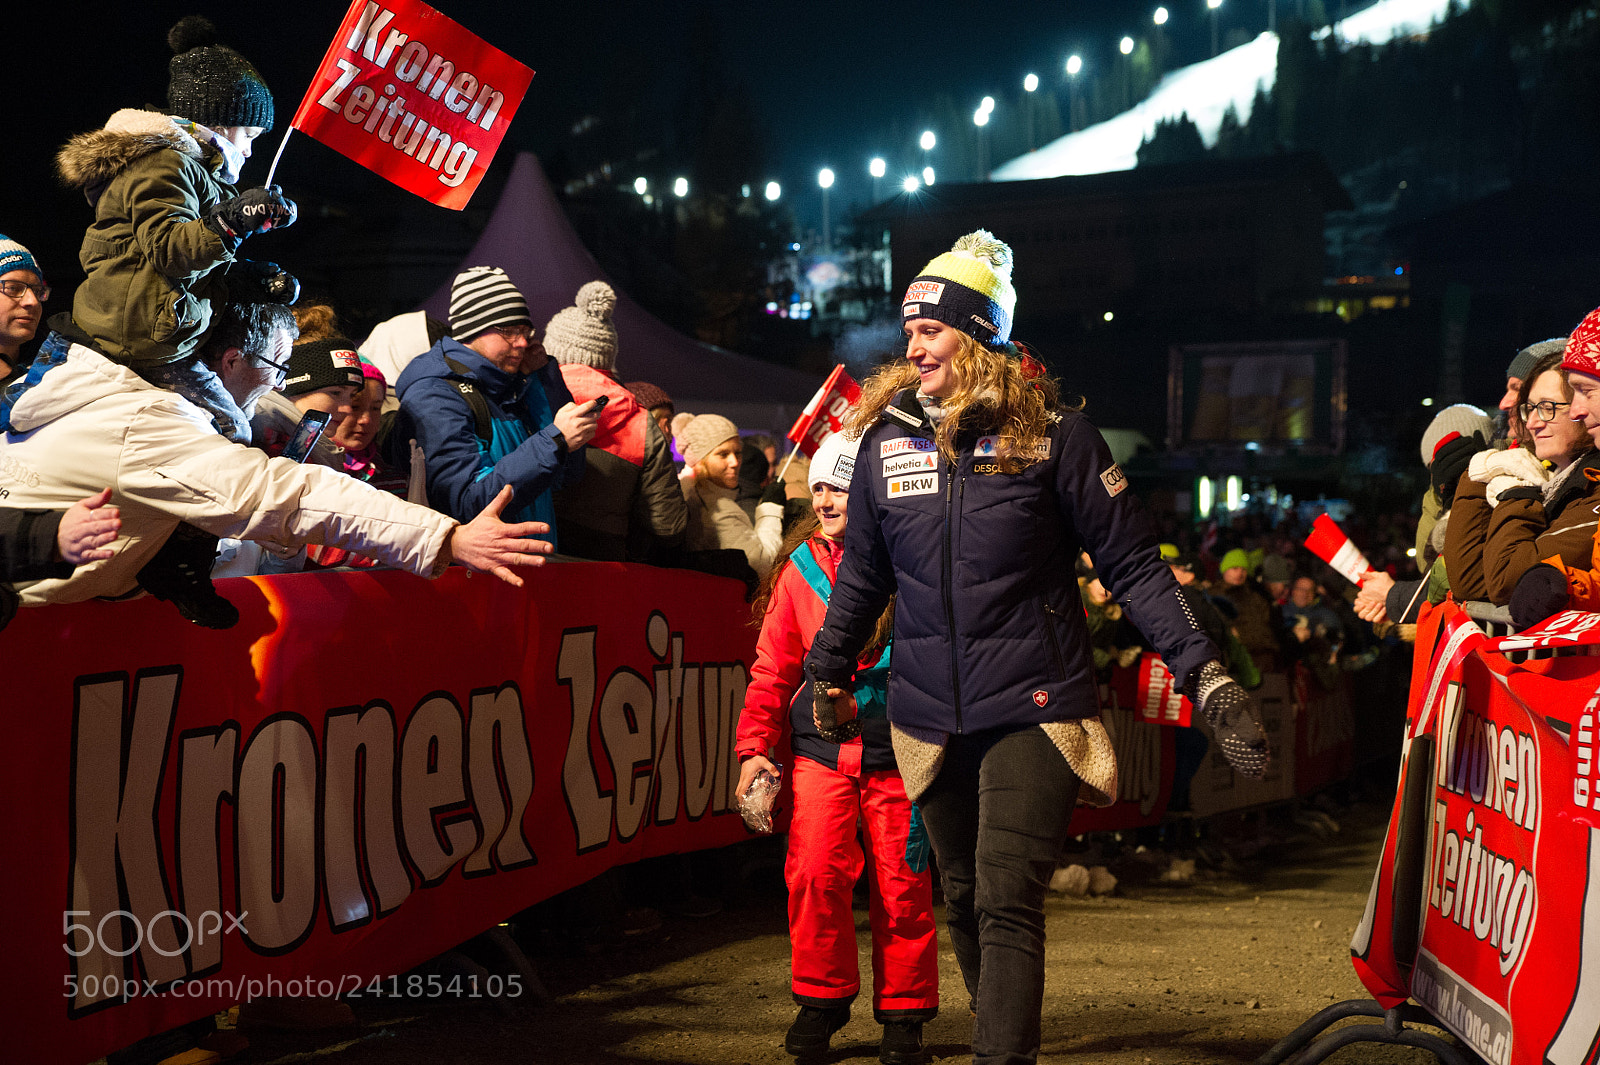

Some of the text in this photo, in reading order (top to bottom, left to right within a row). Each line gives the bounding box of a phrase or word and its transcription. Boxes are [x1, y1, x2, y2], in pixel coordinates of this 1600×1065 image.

[317, 57, 479, 187] Zeitung
[346, 0, 504, 131] Kronen
[242, 203, 266, 216] DAD
[885, 460, 922, 474] helvetia
[902, 478, 934, 492] BKW
[68, 610, 750, 1020] Kronen Zeitun
[1437, 680, 1536, 832] Kronen
[1430, 798, 1534, 977] Zeitung
